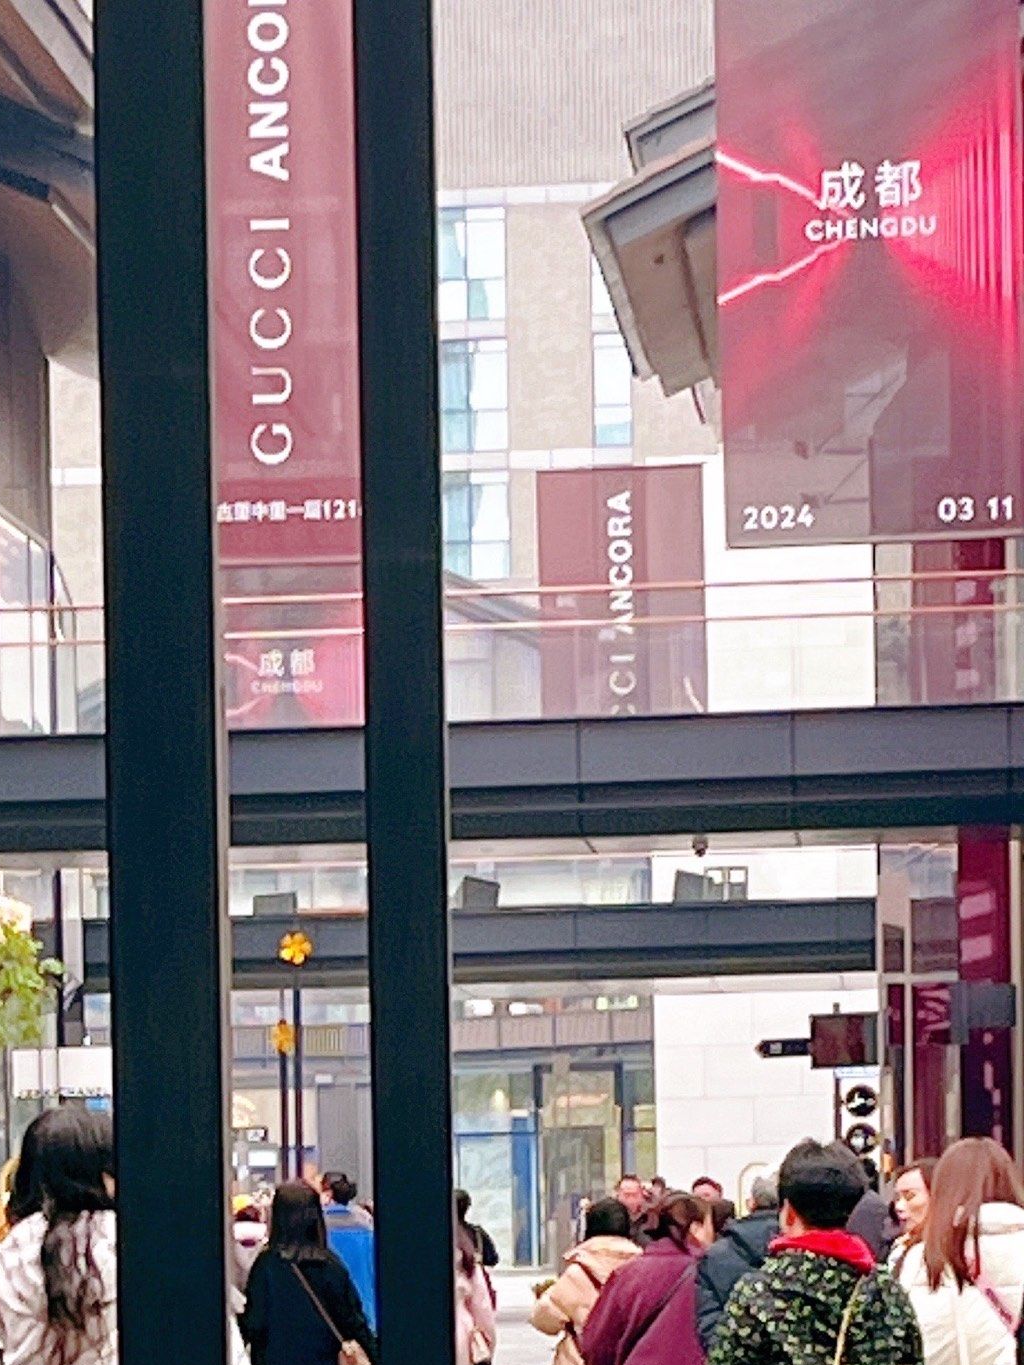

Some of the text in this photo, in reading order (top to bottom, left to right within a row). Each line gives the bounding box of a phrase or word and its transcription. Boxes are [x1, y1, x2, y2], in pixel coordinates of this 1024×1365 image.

[818, 159, 923, 210] 成都
[247, 0, 292, 465] GUCCI ANCO
[805, 215, 937, 241] CHENGDU
[742, 503, 816, 530] 2024
[937, 494, 1014, 523] 03 11
[606, 489, 635, 635] ANCORA
